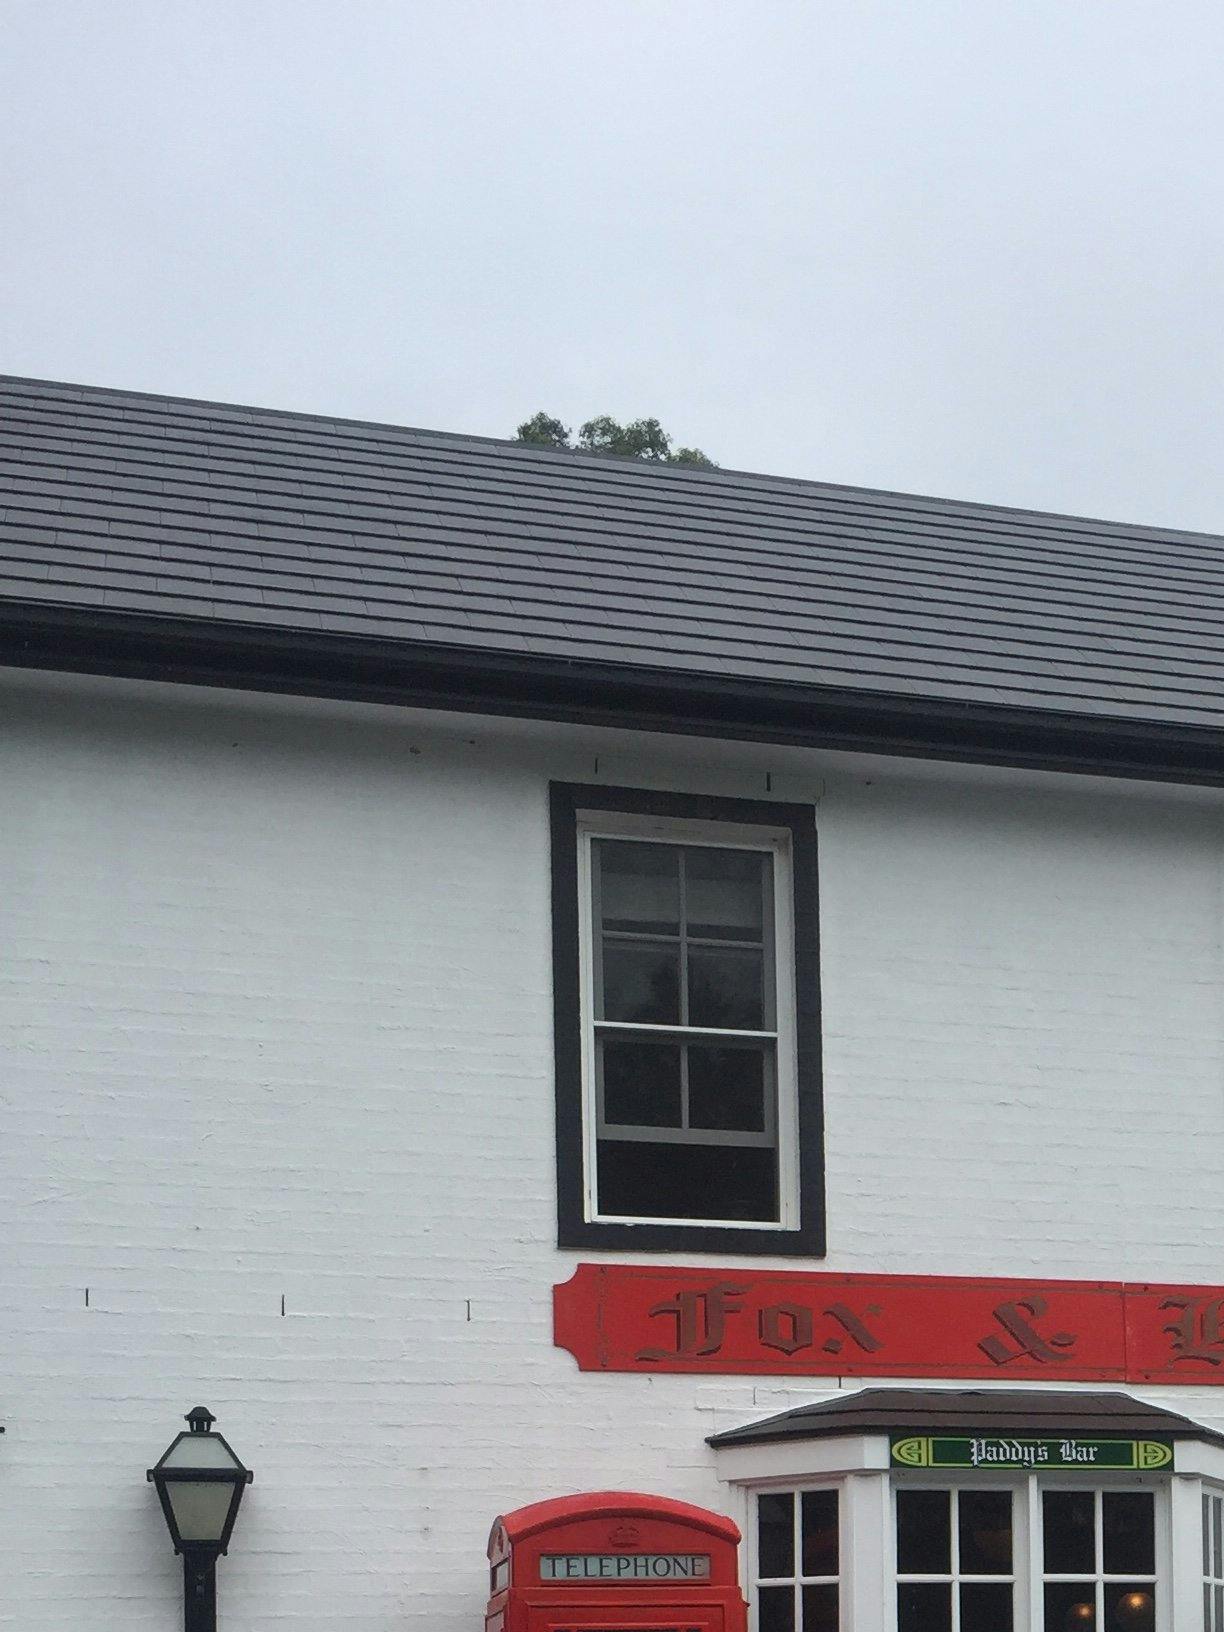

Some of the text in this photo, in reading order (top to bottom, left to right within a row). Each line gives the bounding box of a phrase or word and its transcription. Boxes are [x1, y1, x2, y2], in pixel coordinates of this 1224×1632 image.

[634, 1282, 885, 1363] Fox
[977, 1296, 1078, 1366] &
[969, 1437, 1099, 1468] Paddy's Bar
[546, 1556, 704, 1578] TELEPHONE
